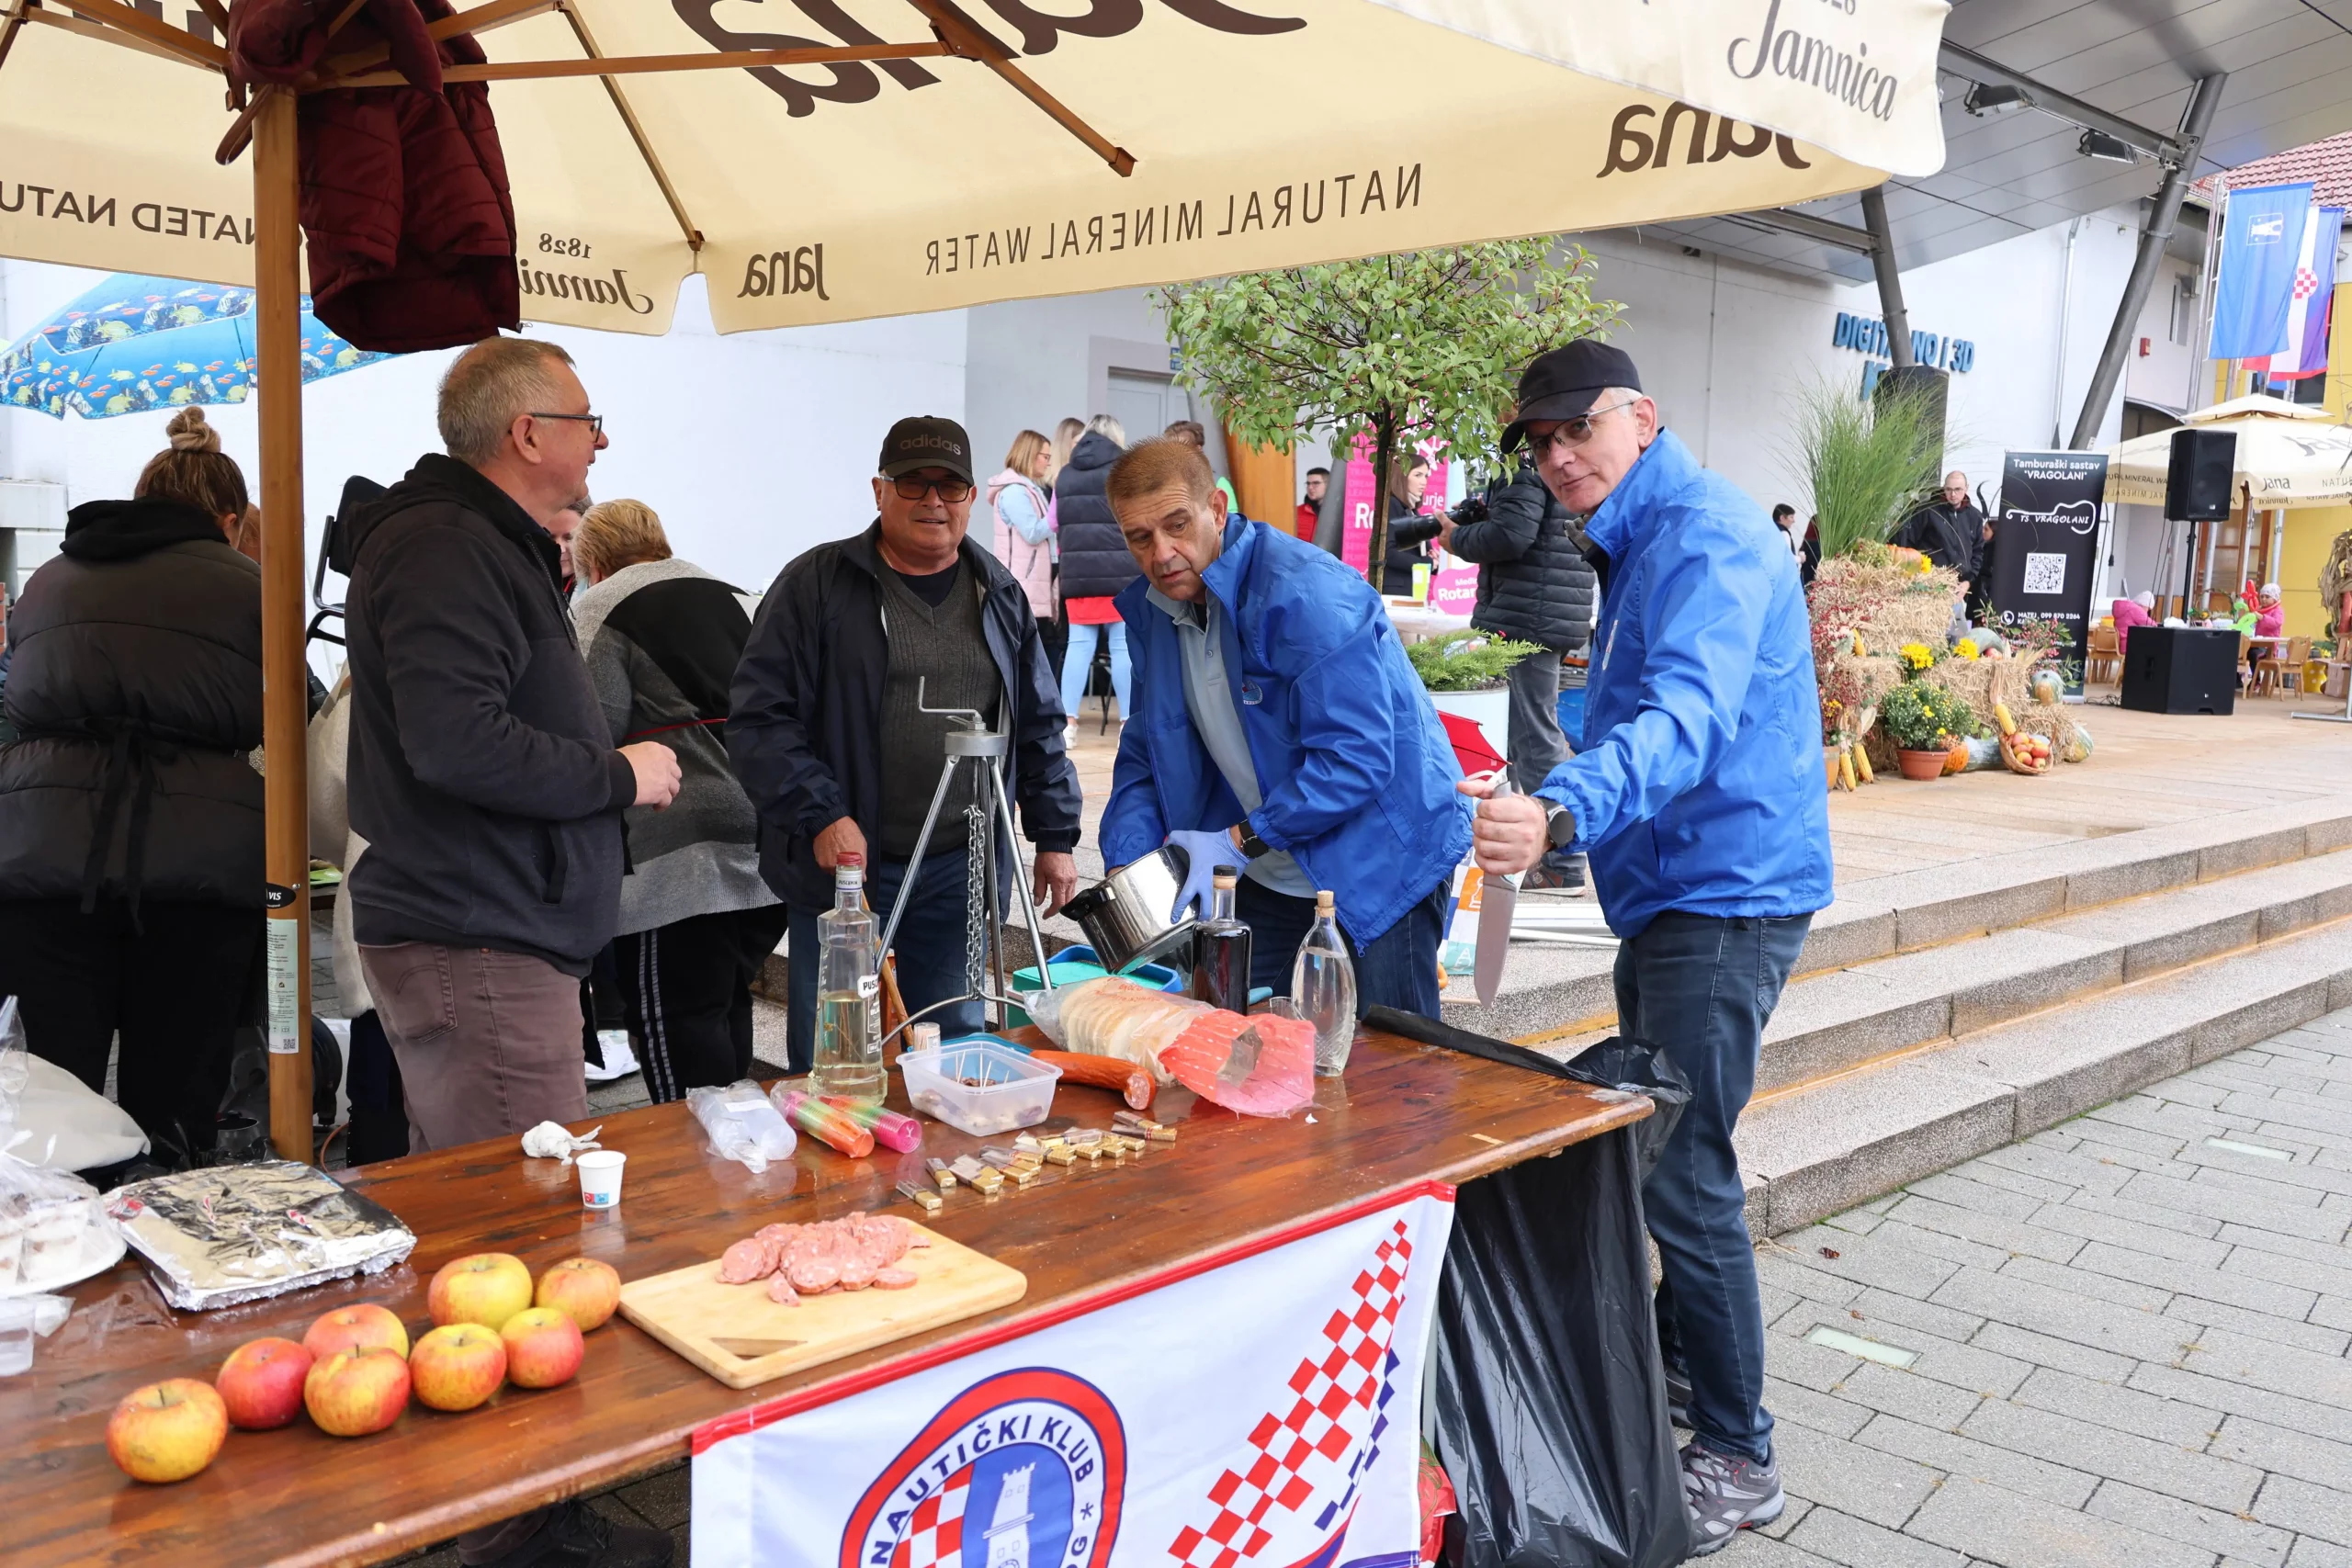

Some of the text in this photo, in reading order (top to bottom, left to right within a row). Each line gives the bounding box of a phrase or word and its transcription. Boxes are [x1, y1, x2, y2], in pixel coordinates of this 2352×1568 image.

[1727, 0, 1898, 121] Jamnica
[1950, 338, 1975, 372] 3D
[900, 434, 961, 456] adidas
[2013, 458, 2100, 469] Tamburaški sastav
[2124, 474, 2154, 483] MINERAL
[2260, 478, 2291, 491] Jana
[2035, 515, 2090, 525] VRAGOLANI
[870, 1415, 1094, 1565] NAUTIČKI KLUB
